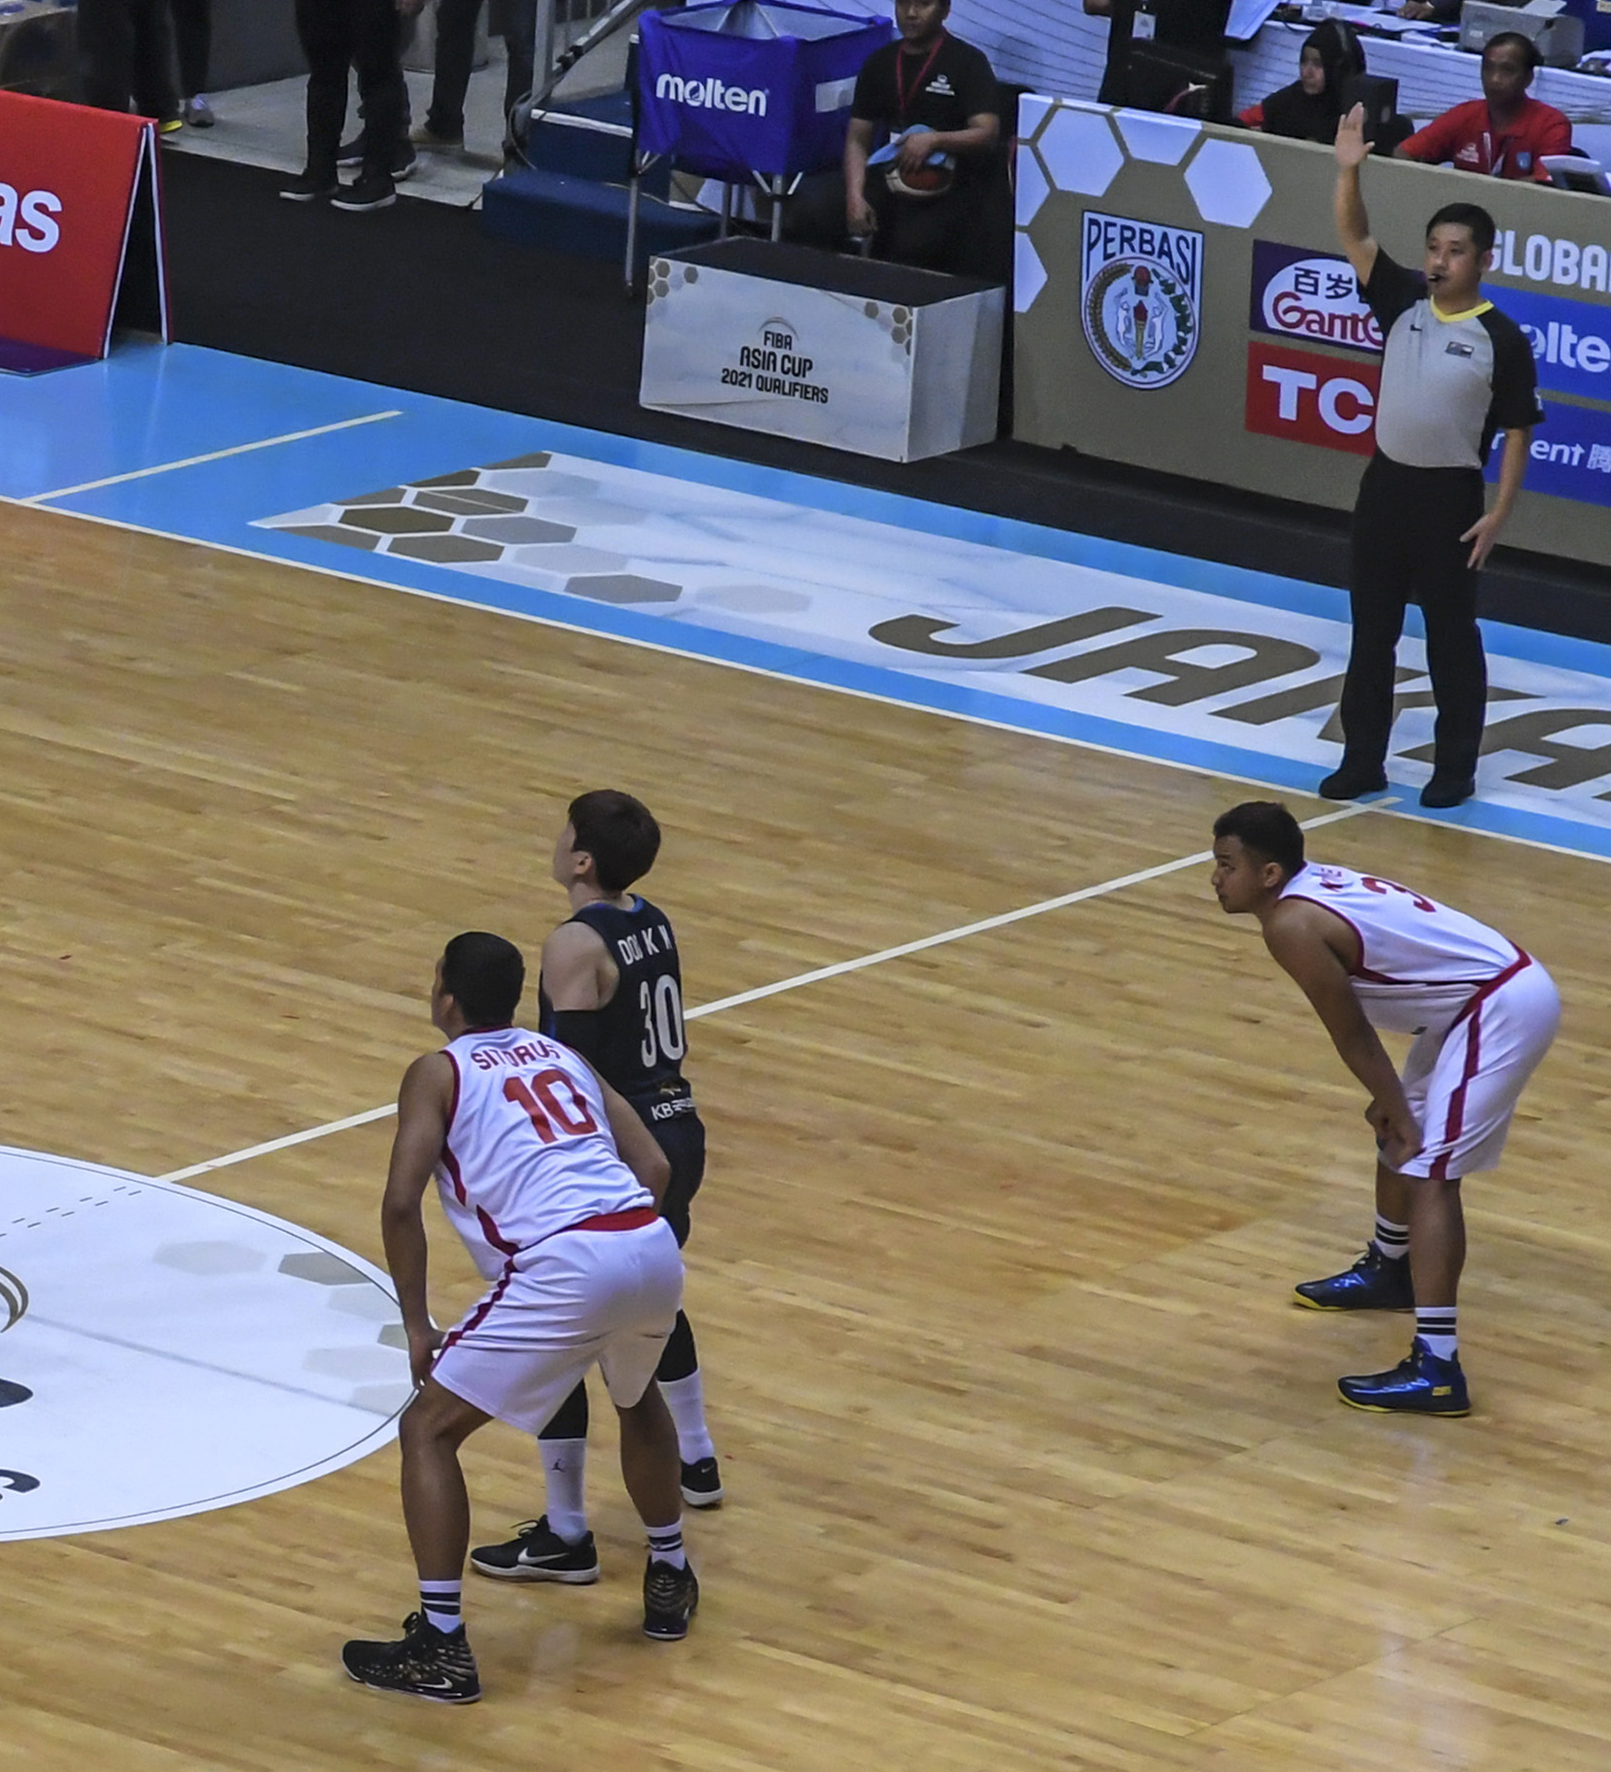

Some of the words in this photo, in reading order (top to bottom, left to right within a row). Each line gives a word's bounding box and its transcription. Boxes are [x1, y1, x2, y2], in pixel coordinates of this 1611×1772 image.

[656, 73, 768, 117] molten
[1085, 217, 1197, 303] PERBASI
[1294, 266, 1372, 304] 百岁
[1489, 228, 1611, 293] LOBA
[763, 330, 793, 351] FIBA
[1272, 291, 1384, 346] Gante
[739, 346, 777, 373] ASIA
[780, 354, 813, 379] CUP
[1518, 321, 1611, 373] olte
[721, 368, 752, 388] 2021
[755, 374, 830, 404] QUALIFIERS
[1262, 364, 1375, 435] TC
[868, 606, 1611, 798] JAKA
[641, 927, 660, 956] K
[640, 974, 685, 1068] 30
[502, 1069, 598, 1144] 10
